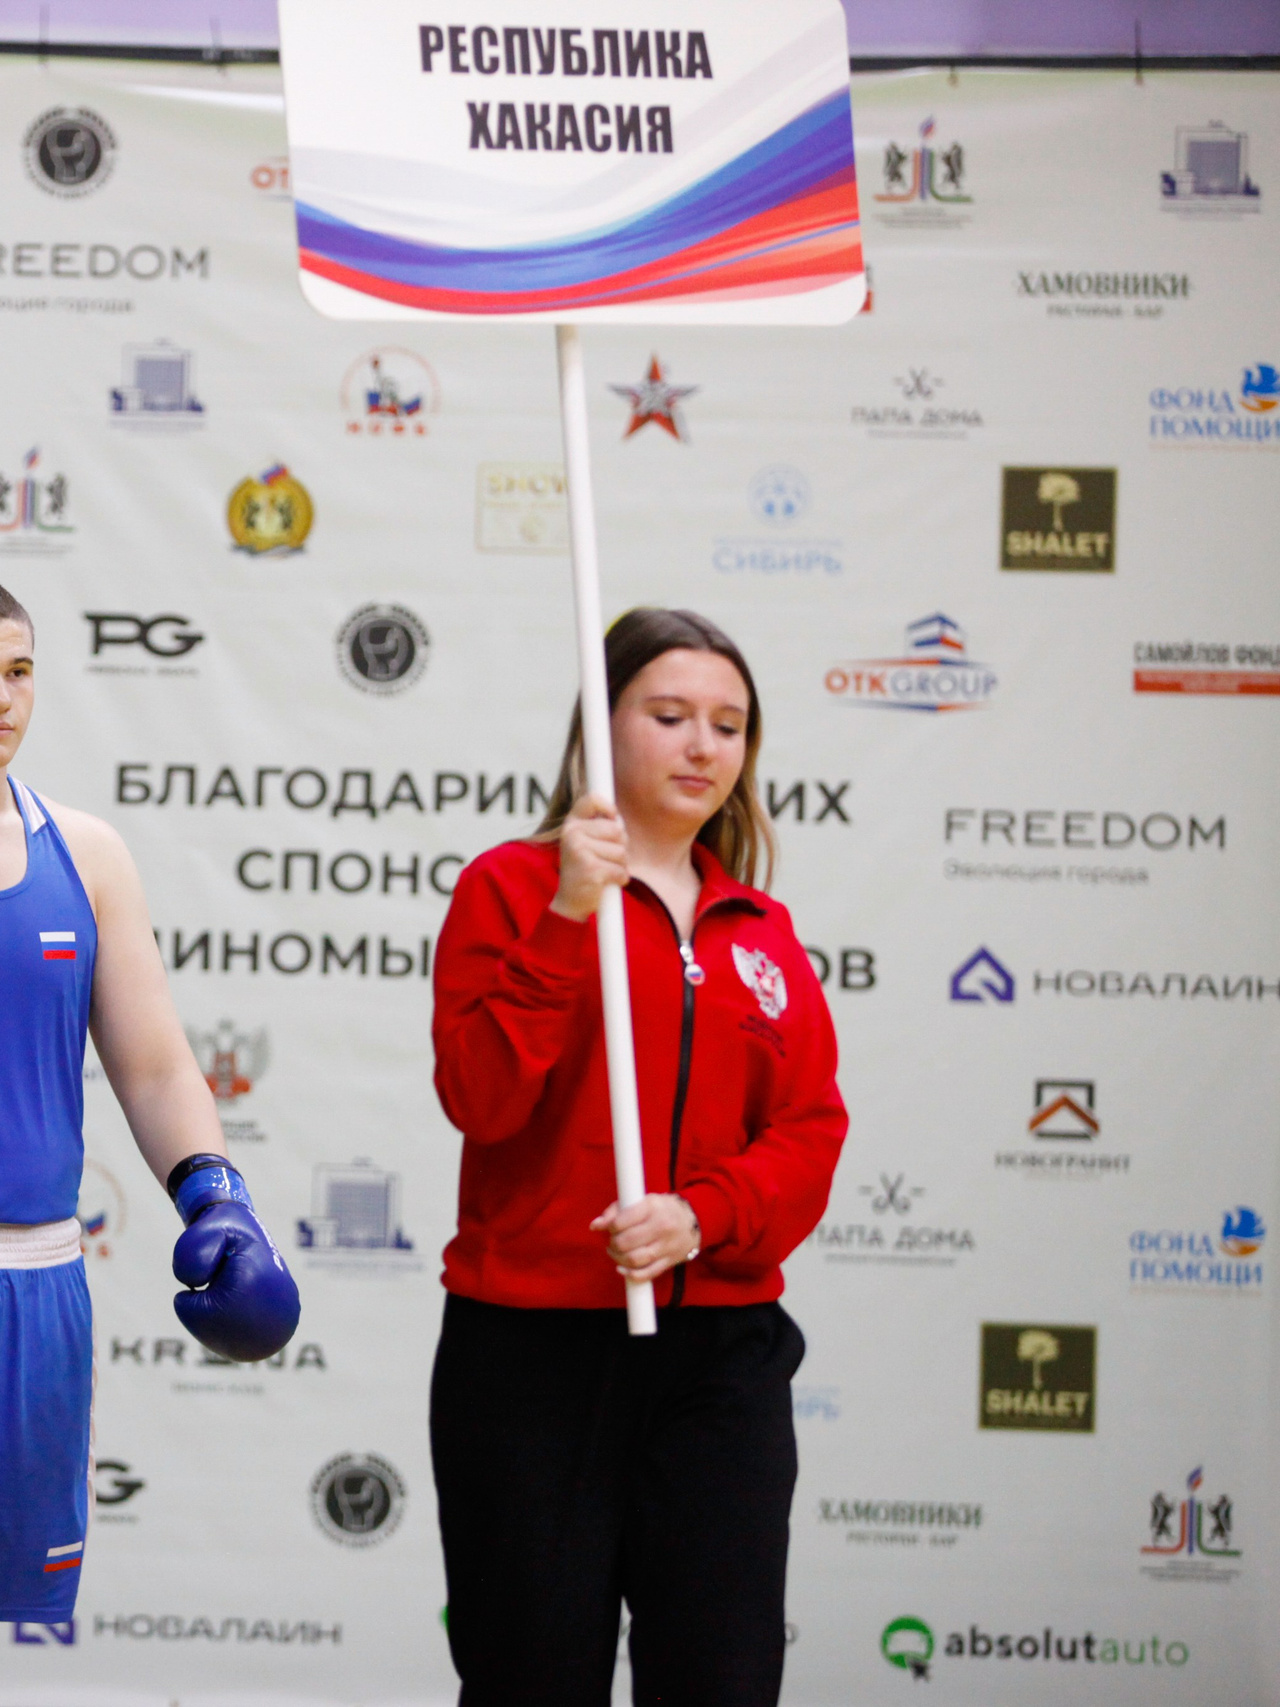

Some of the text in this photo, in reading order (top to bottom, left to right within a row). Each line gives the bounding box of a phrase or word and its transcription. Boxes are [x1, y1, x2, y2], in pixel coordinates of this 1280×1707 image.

[419, 24, 713, 79] РЕСПУБЛИКА
[466, 101, 673, 154] ХАКАСИЯ
[1018, 270, 1190, 299] ХАМОВНИКИ
[1007, 530, 1110, 557] SHALET
[711, 548, 844, 574] СИБИРЬ
[84, 610, 204, 657] PG
[1133, 640, 1230, 664] САМОЙЛОВ
[824, 668, 998, 698] OTKGROUP
[117, 764, 553, 818] БЛАГОДАРИМ
[944, 808, 1226, 850] FREEDOM
[237, 848, 466, 896] СПОНС
[152, 929, 432, 978] ИНОМЫ
[894, 1226, 976, 1251] ДОМА
[1129, 1258, 1263, 1288] ПОМОЩИ
[111, 1336, 327, 1371] KRA
[986, 1388, 1089, 1417] SHALET
[819, 1499, 981, 1529] ХАМОВНИКИ
[945, 1623, 1190, 1668] absolutauto
